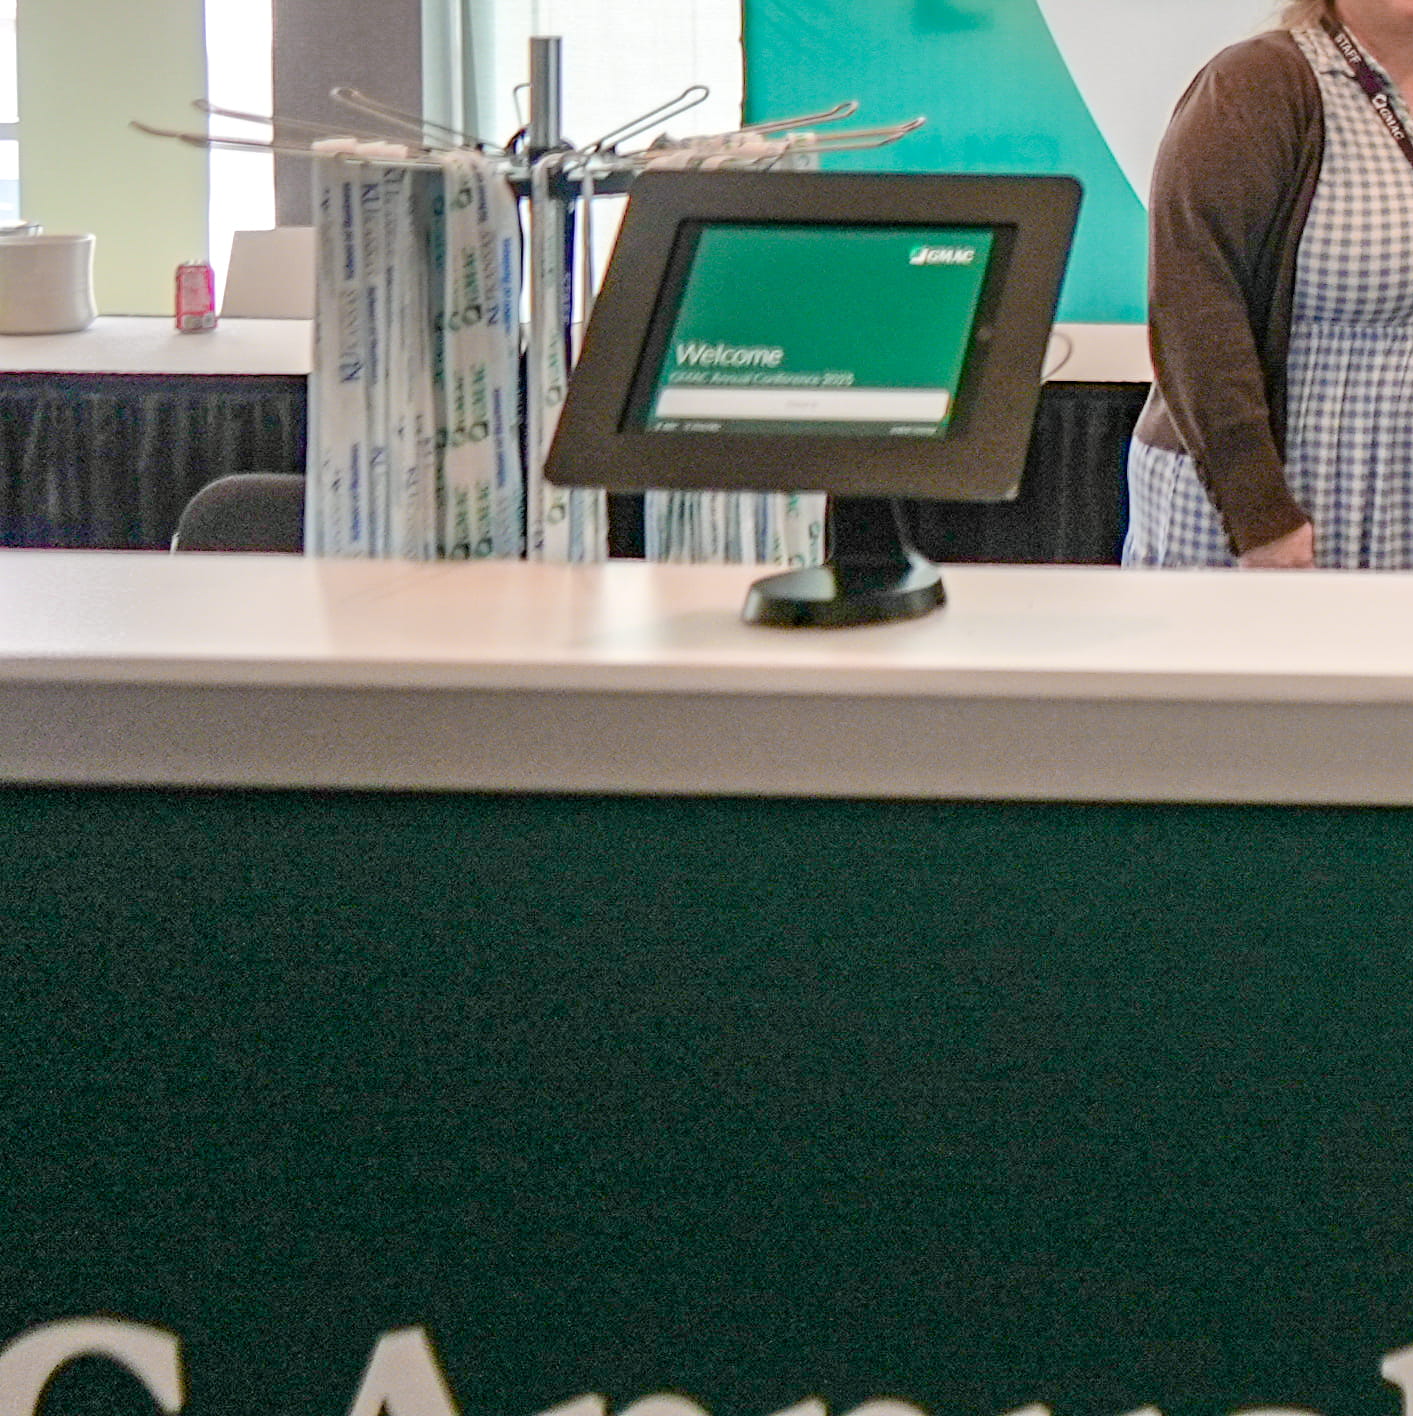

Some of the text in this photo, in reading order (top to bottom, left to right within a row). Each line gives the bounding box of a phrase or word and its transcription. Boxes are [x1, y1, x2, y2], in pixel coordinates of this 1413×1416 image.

[1334, 33, 1362, 64] STAFF
[1380, 107, 1404, 140] GMAC
[927, 246, 975, 265] GMAC
[676, 342, 785, 369] Welcome
